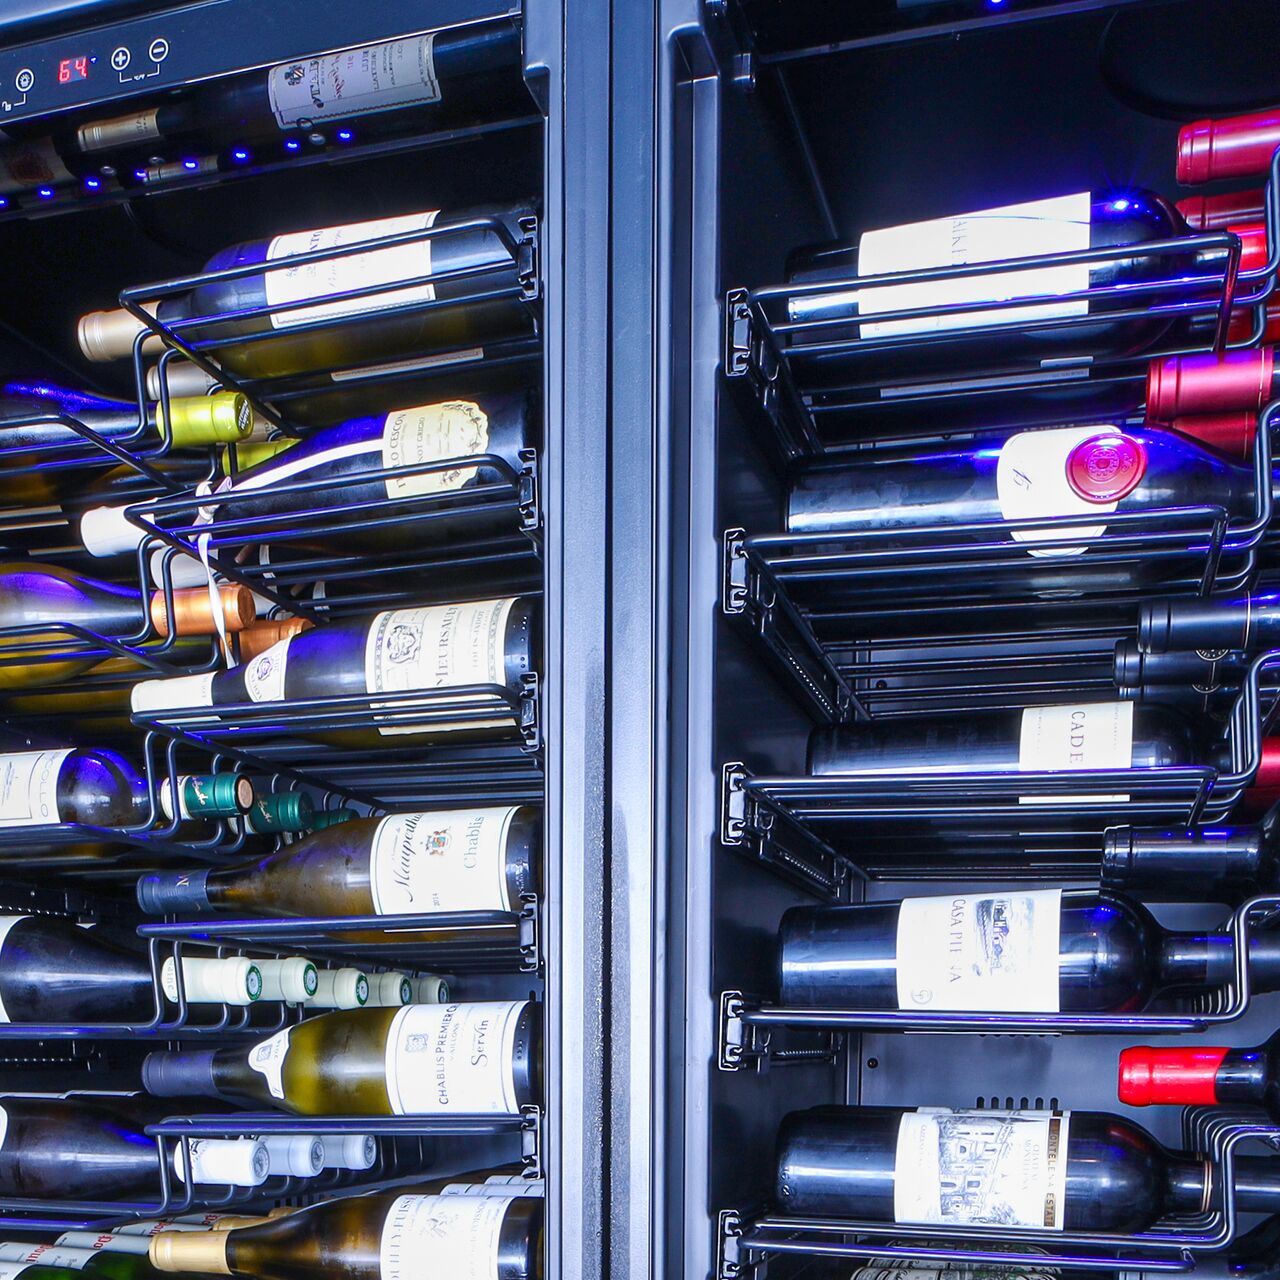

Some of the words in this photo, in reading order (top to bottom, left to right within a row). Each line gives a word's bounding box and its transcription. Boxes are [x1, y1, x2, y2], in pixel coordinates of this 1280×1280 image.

[389, 411, 407, 449] CESCON
[1069, 711, 1087, 765] CADE
[463, 816, 486, 869] Chablis
[948, 898, 967, 928] CASA
[434, 1013, 456, 1054] PREMIER
[470, 1019, 490, 1067] Servin
[435, 1056, 449, 1106] CHABLIS
